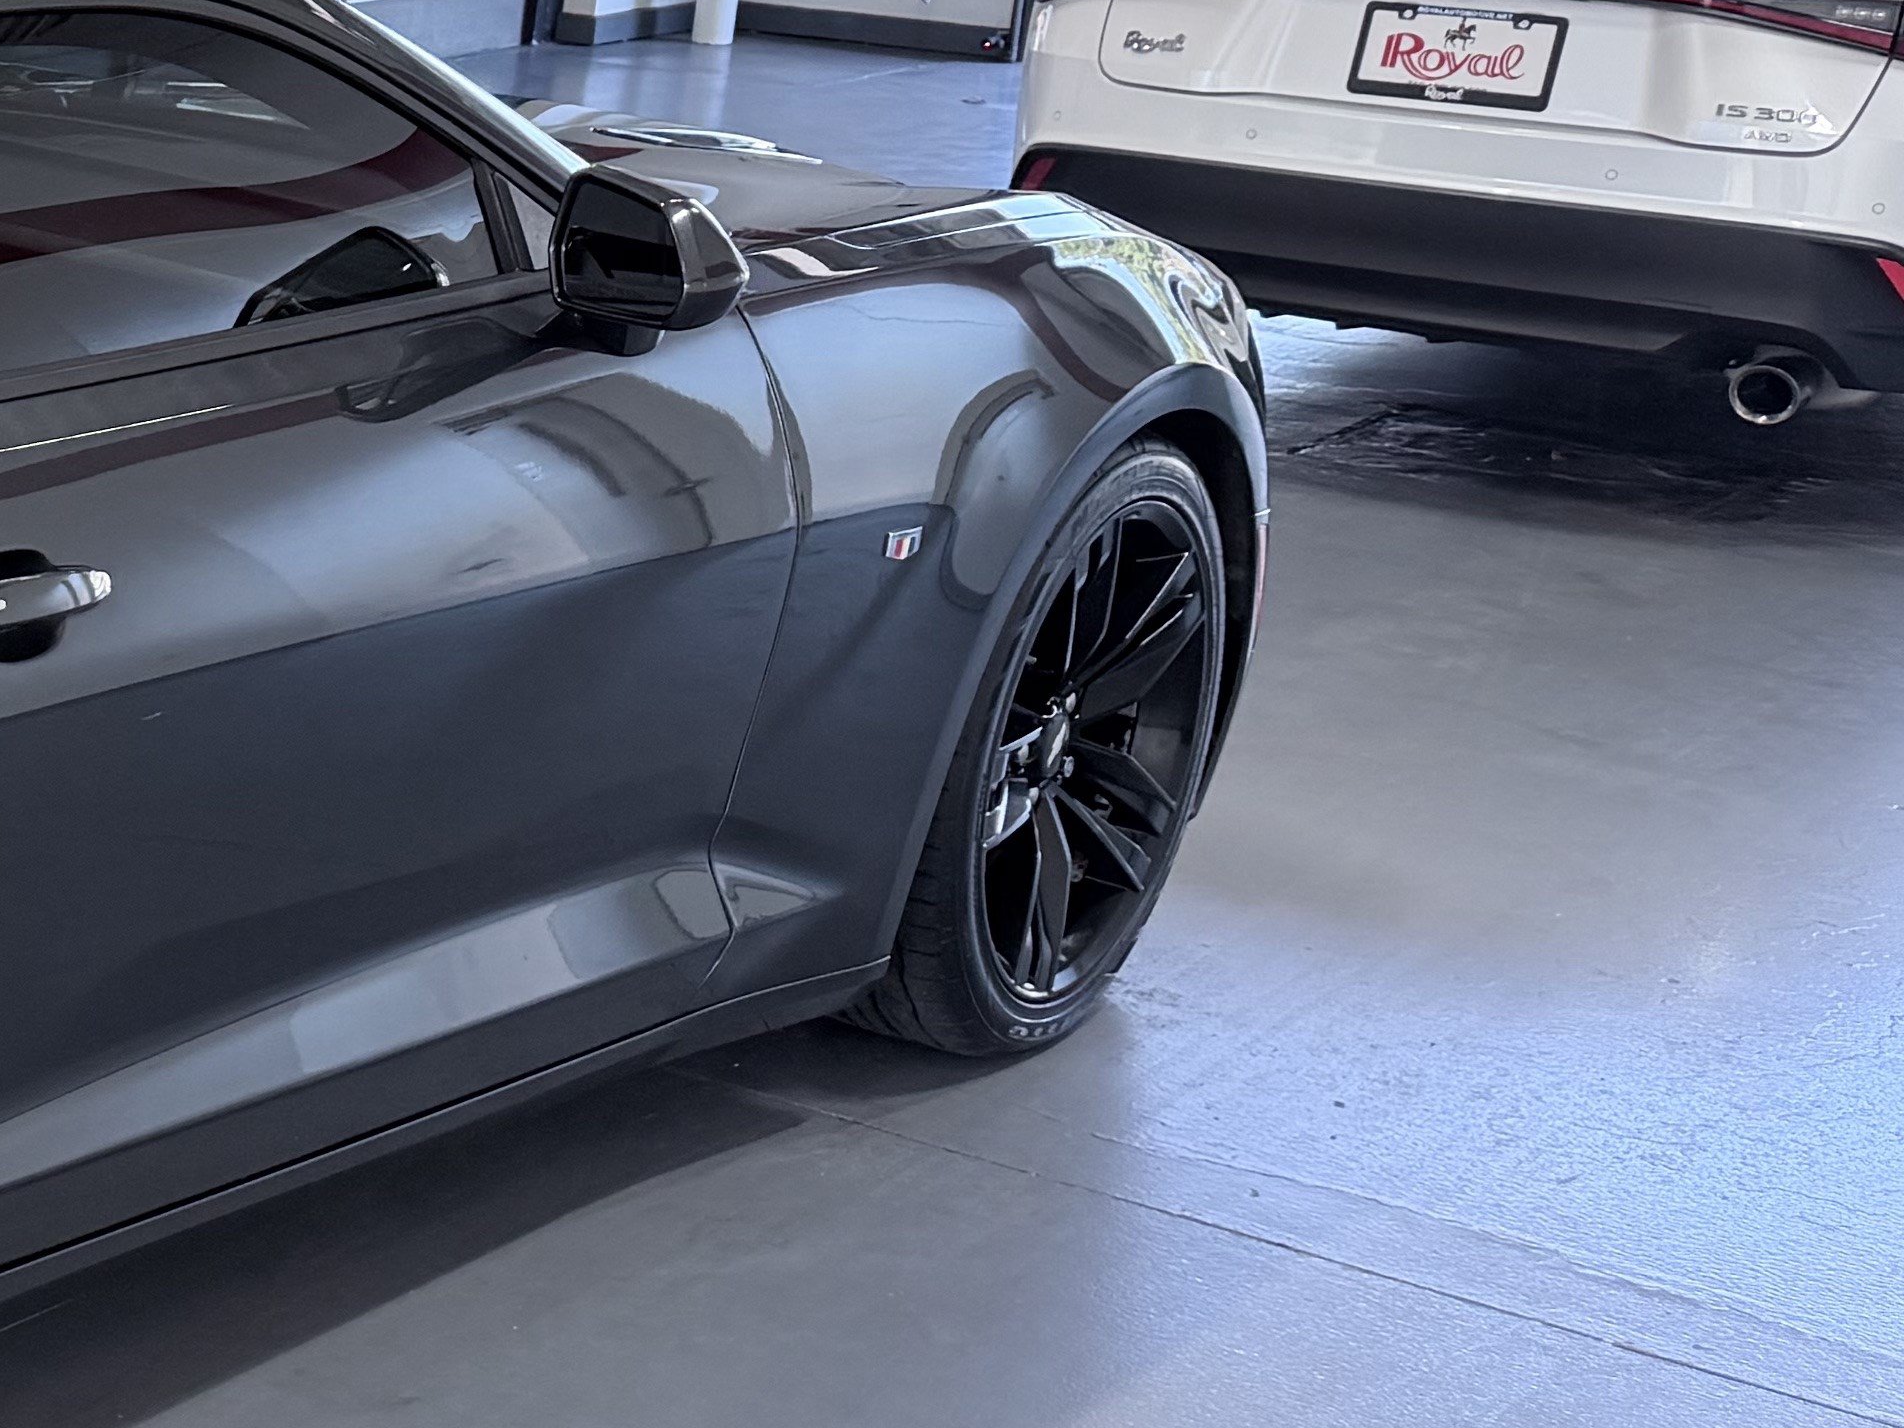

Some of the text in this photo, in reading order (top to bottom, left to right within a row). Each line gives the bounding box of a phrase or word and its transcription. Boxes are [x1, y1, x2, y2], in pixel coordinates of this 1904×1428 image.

[1123, 30, 1186, 53] Royal
[1380, 32, 1525, 81] Royal
[1715, 103, 1748, 118] IS
